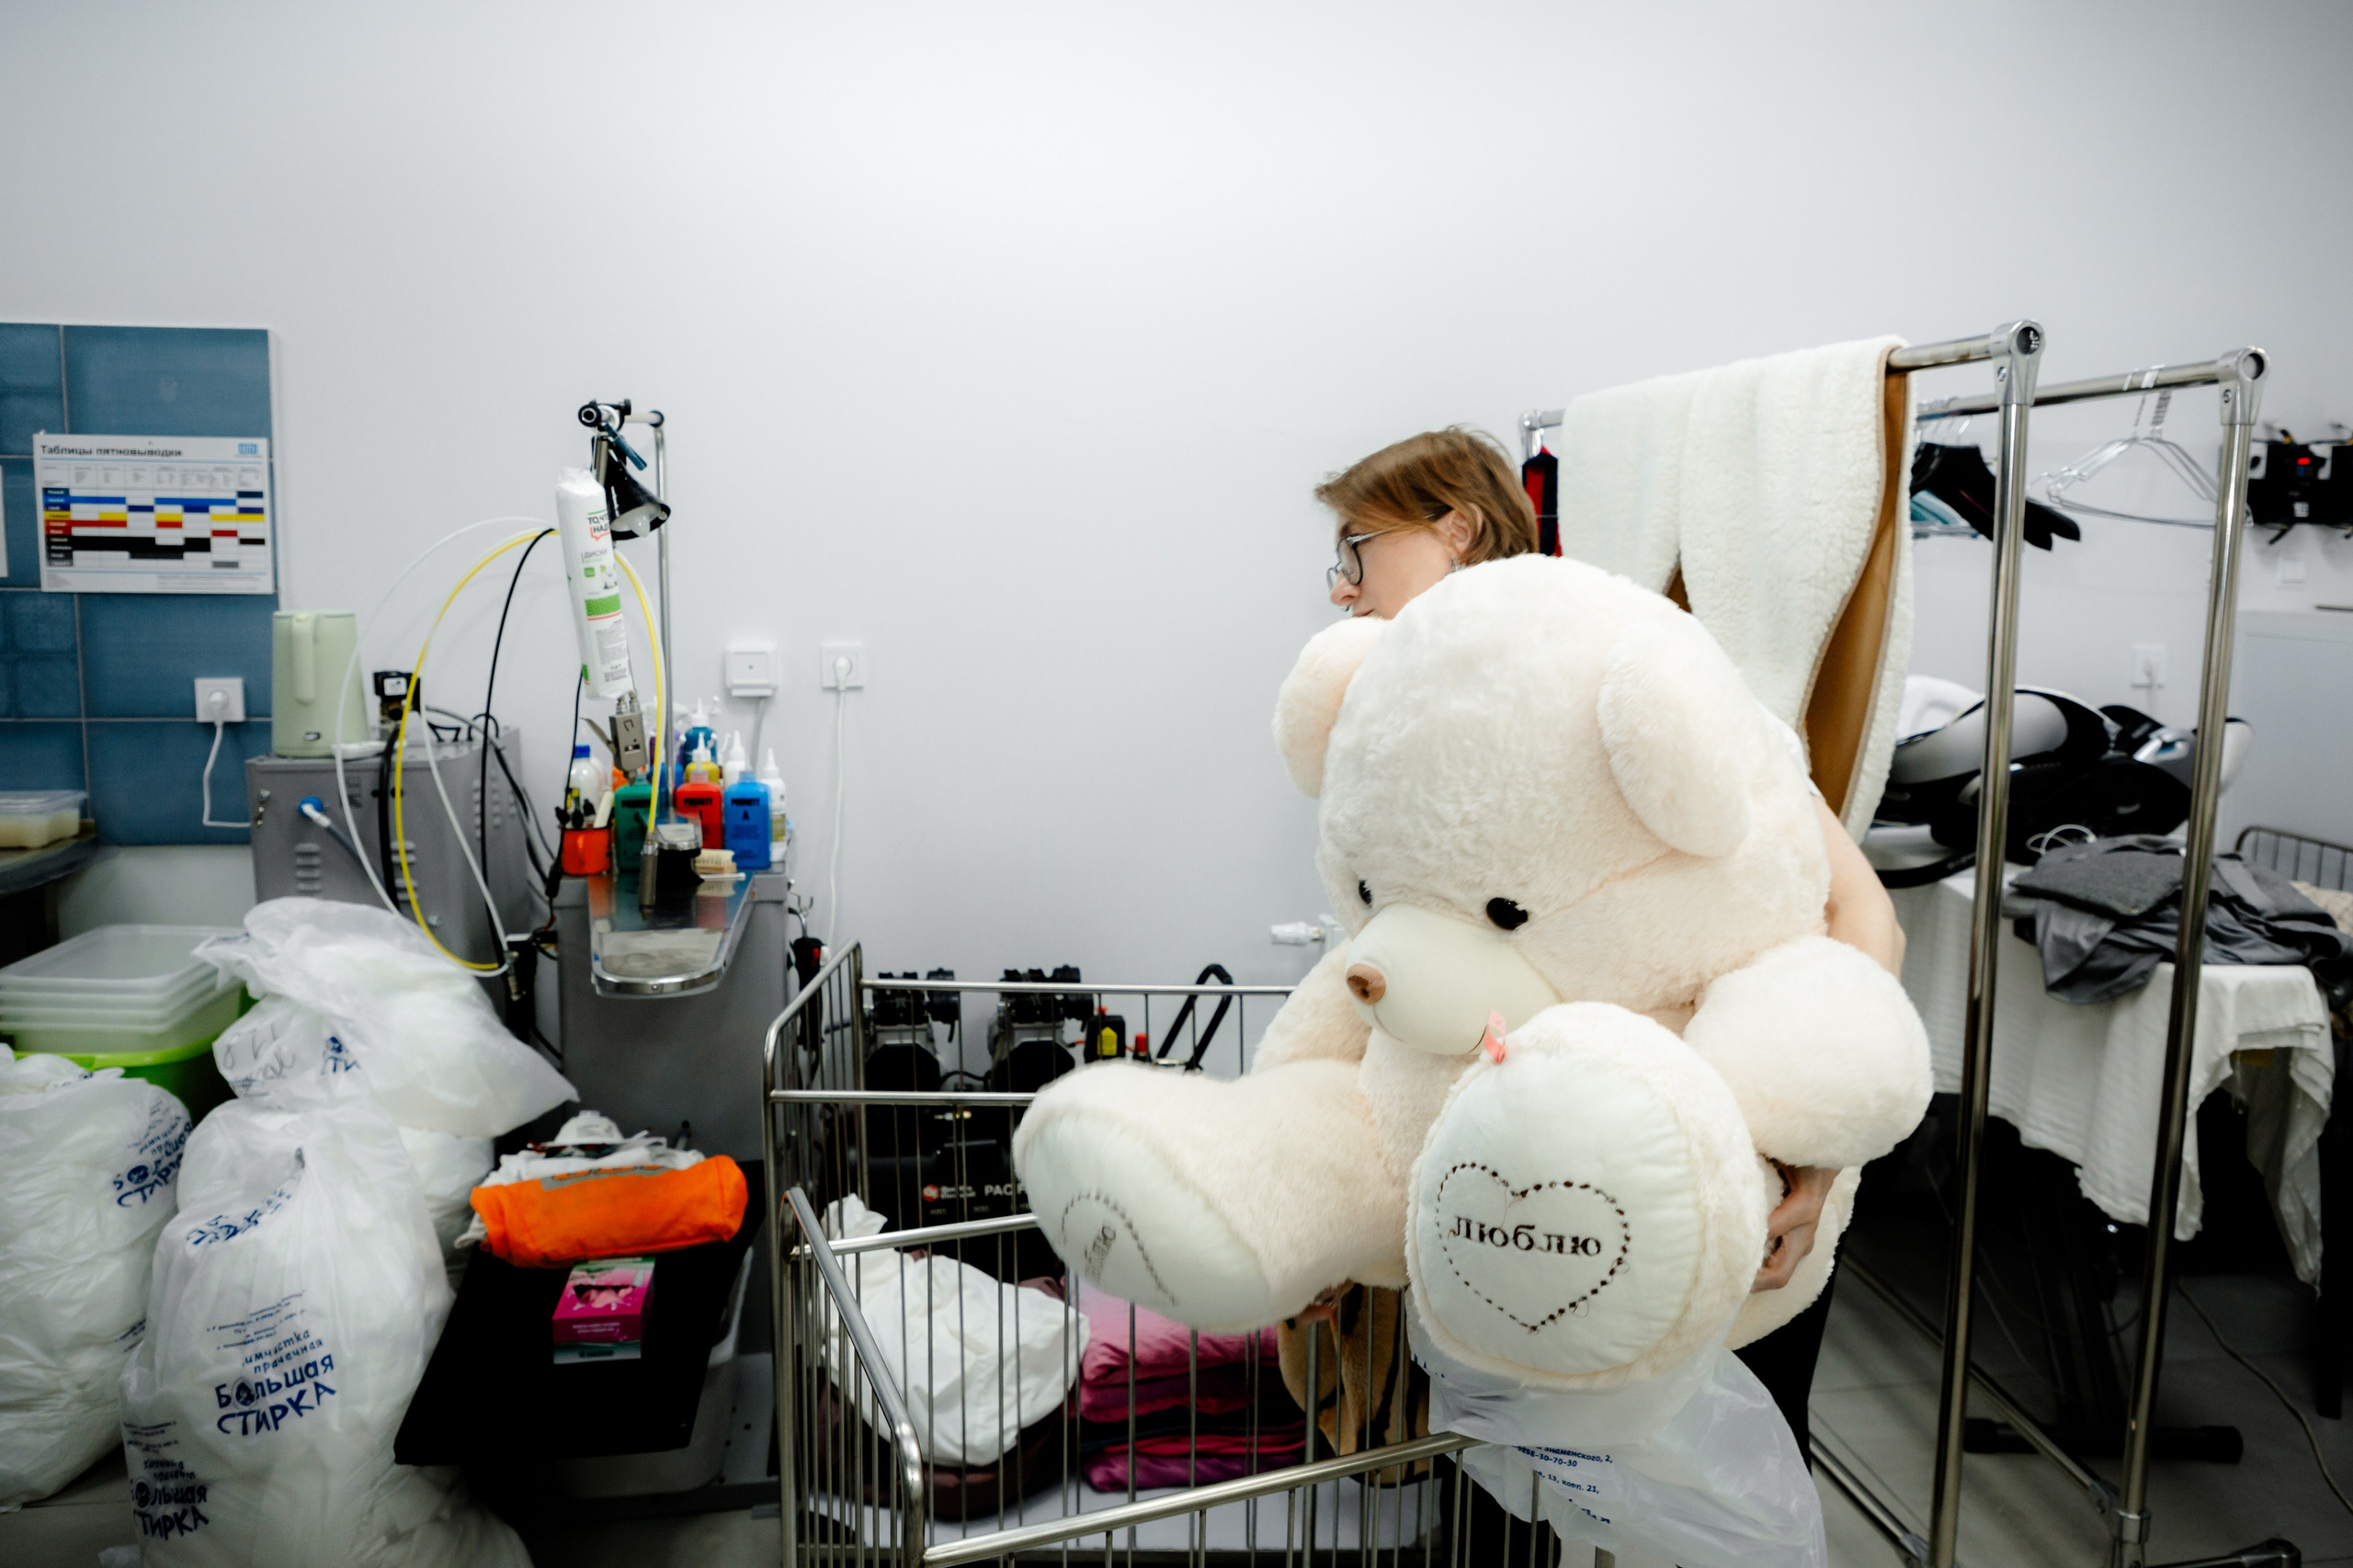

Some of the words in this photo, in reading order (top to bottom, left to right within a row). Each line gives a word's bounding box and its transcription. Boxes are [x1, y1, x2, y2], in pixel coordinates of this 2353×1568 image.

[40, 445, 93, 458] Таблицы
[96, 448, 183, 459] пятновыводки
[593, 523, 610, 534] НАД
[1448, 1215, 1601, 1257] люблю
[242, 1329, 311, 1367] имчистка
[254, 1338, 324, 1374] прачечная
[216, 1381, 337, 1437] СТИРКА
[1586, 1484, 1600, 1494] 21,
